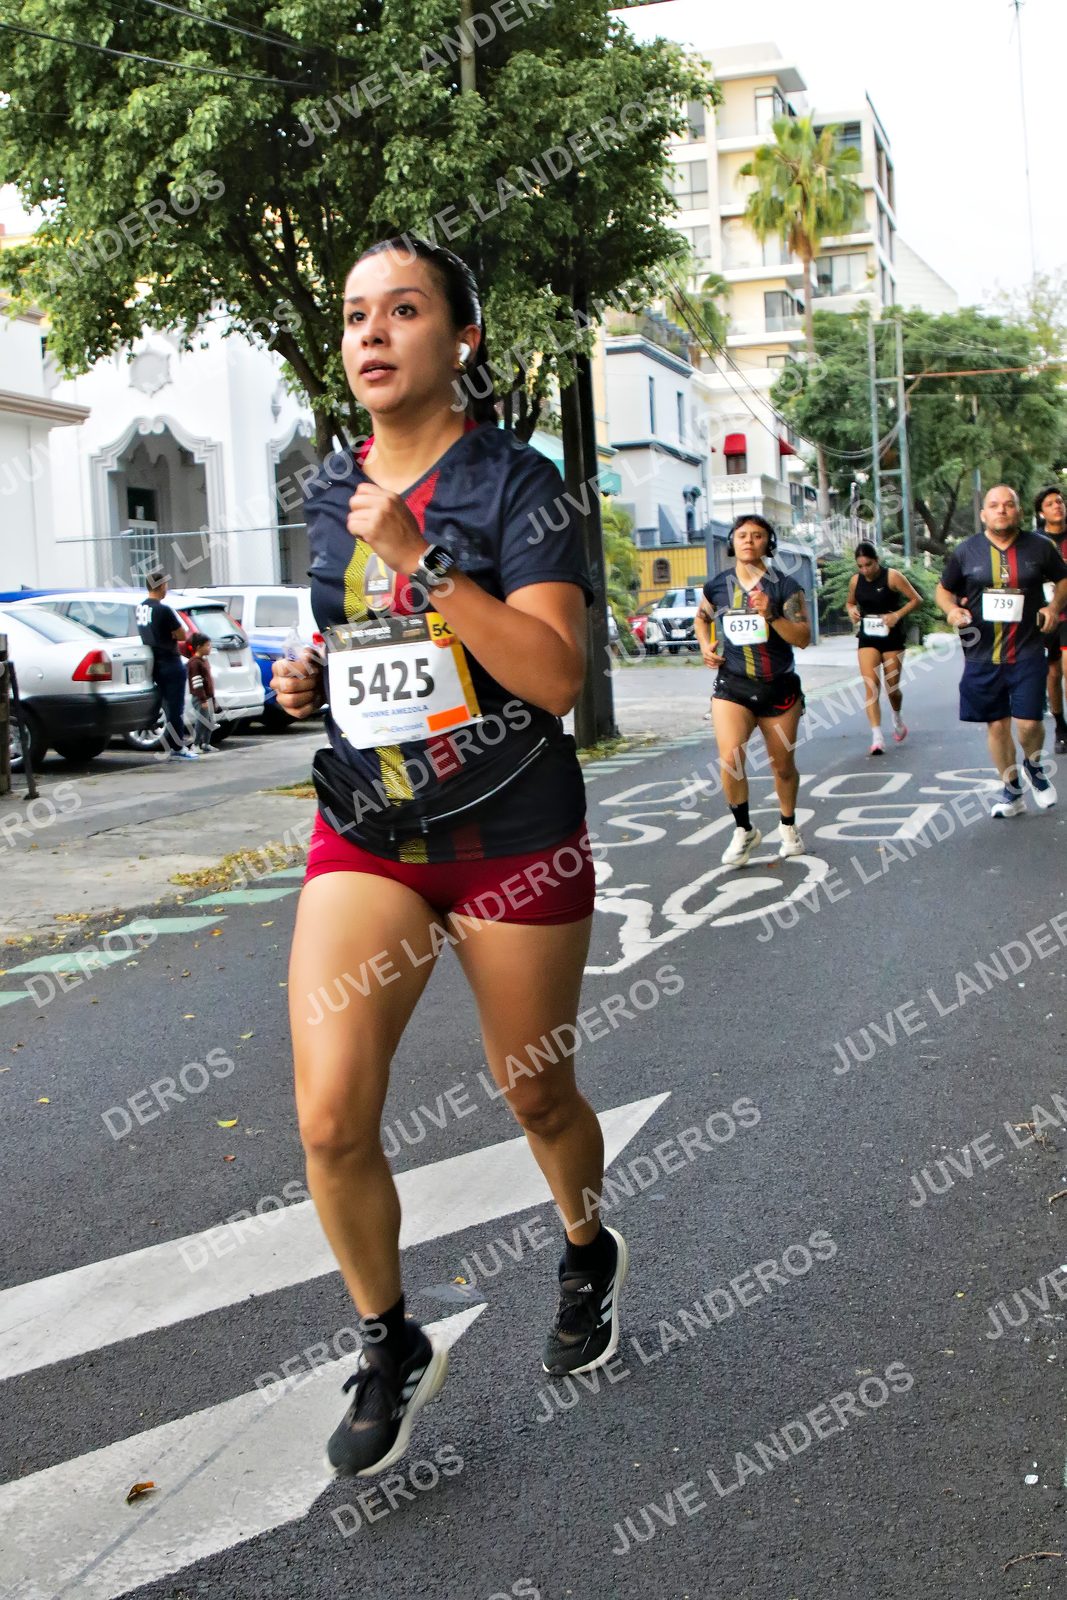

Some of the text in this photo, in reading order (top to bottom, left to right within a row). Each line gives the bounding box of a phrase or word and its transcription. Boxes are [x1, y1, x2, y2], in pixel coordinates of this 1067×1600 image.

[993, 598, 1014, 609] 739
[729, 619, 759, 633] 6375
[348, 658, 435, 706] 5425
